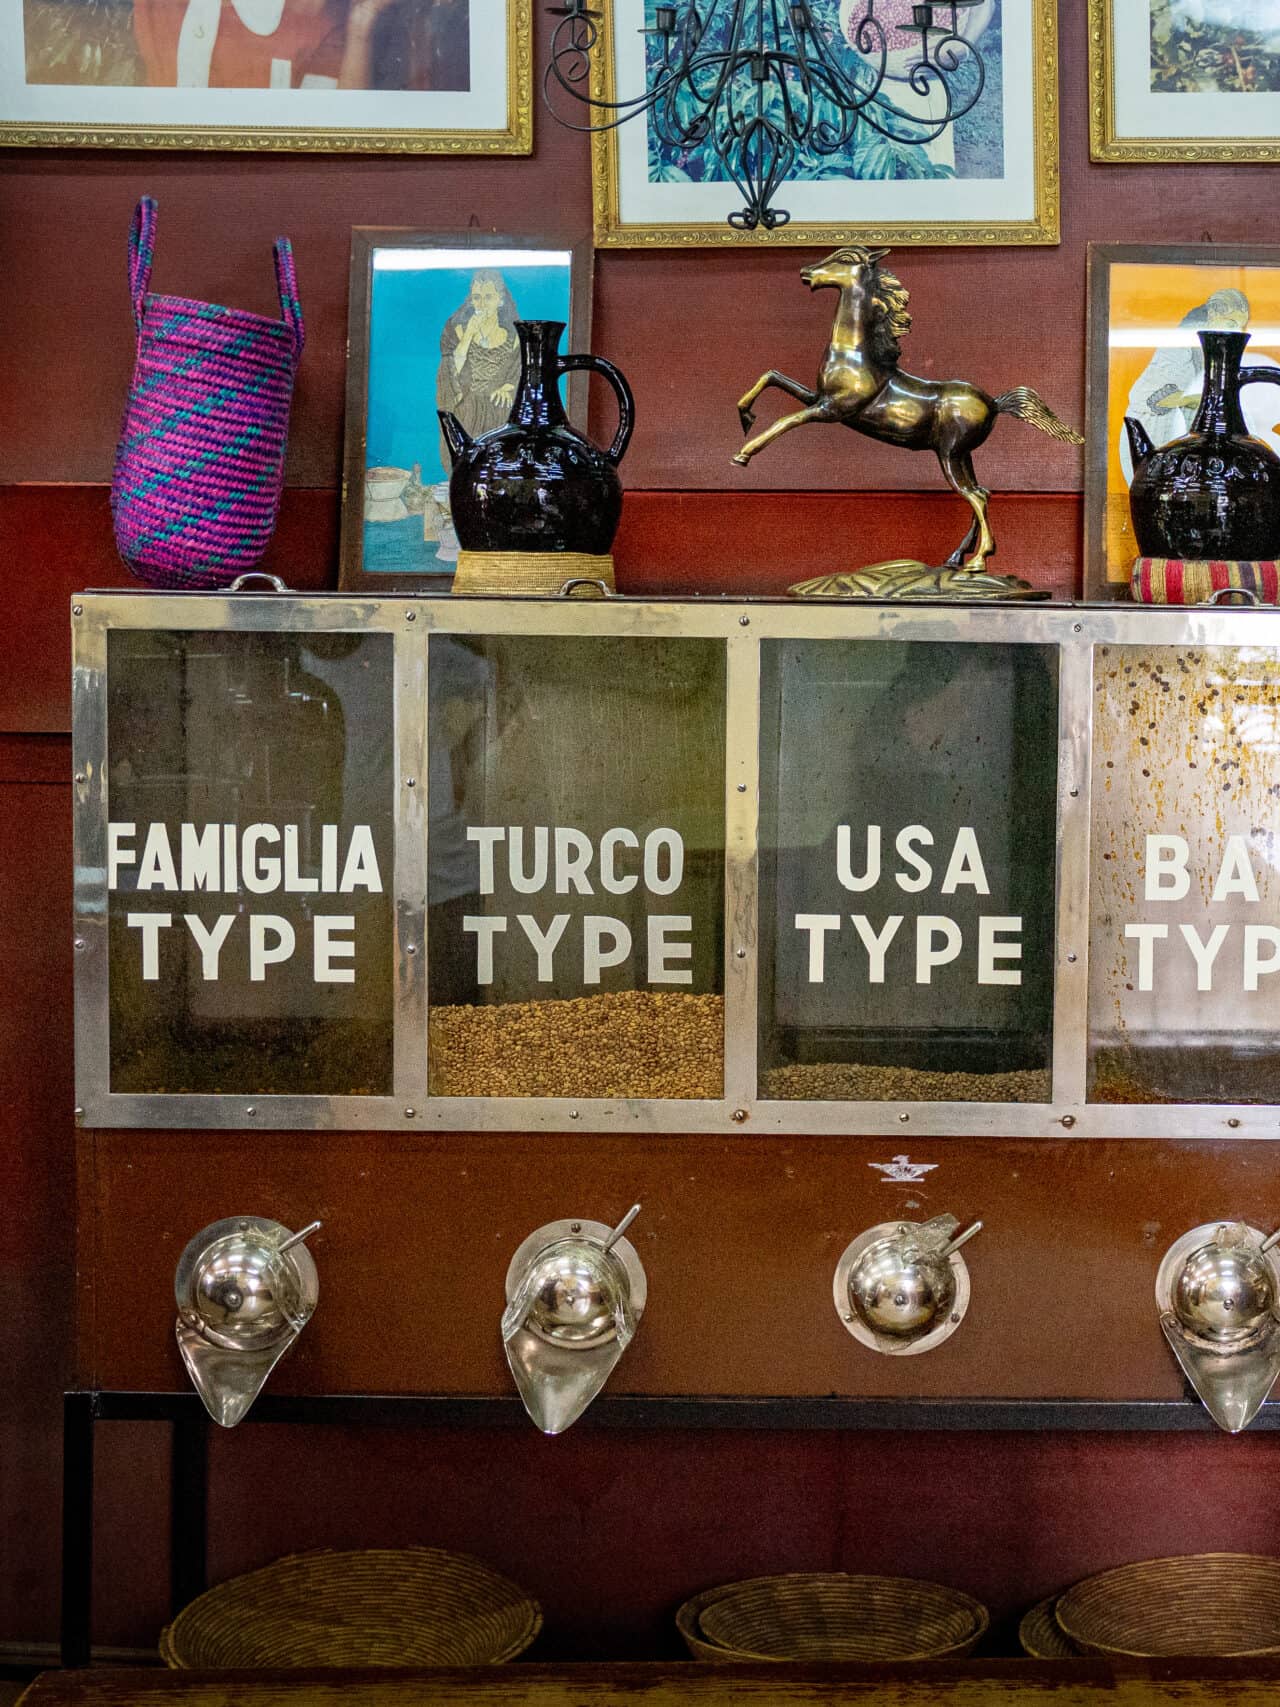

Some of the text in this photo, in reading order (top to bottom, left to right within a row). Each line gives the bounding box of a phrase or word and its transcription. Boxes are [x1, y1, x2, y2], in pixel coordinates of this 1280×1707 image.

[108, 822, 383, 894] FAMIGLIA
[466, 826, 684, 896] TURCO
[836, 824, 991, 895] USA
[127, 912, 356, 983] TYPE
[463, 914, 693, 985] TYPE
[795, 913, 1023, 985] TYPE
